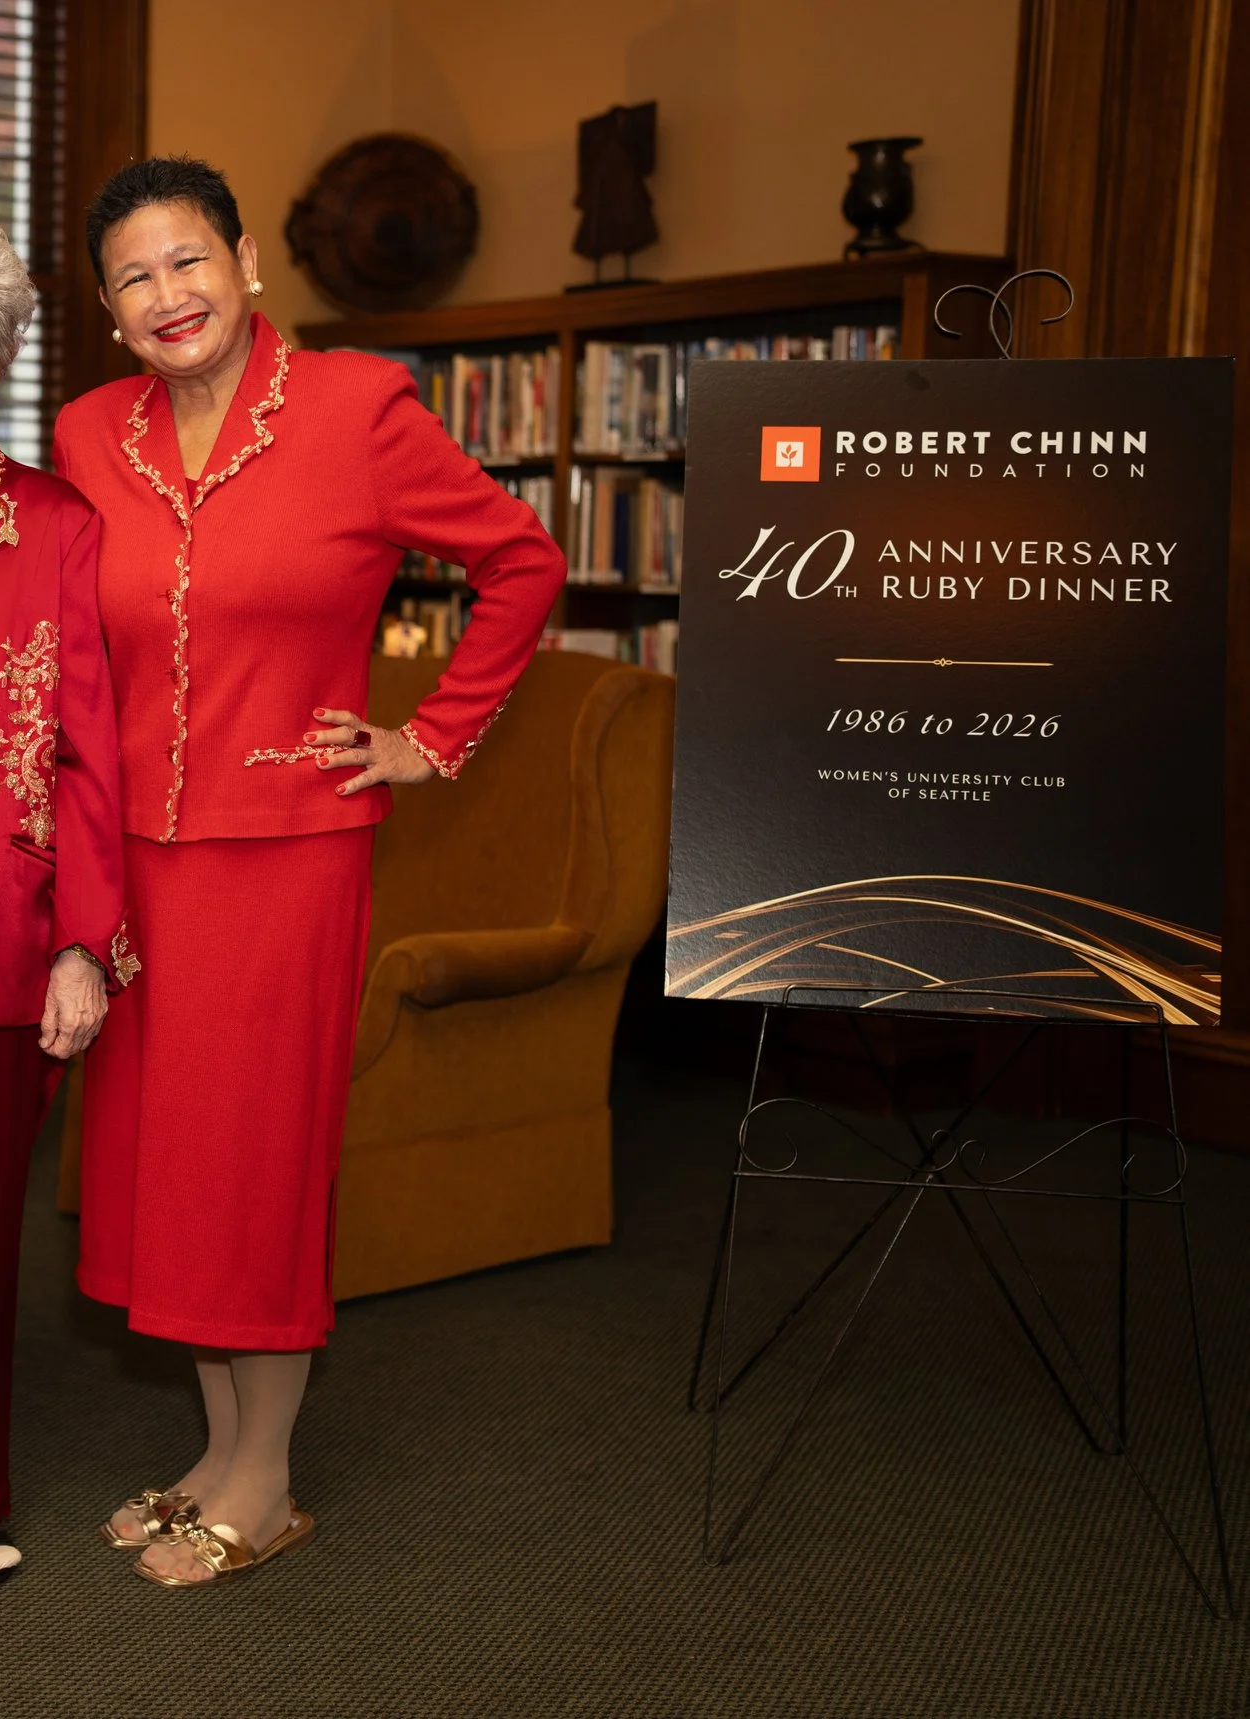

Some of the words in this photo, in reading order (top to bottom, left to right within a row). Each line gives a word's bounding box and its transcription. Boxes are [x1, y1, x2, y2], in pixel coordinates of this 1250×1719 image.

[837, 432, 990, 454] ROBERT
[1011, 431, 1146, 454] CHINN
[835, 462, 1144, 478] FOUNDATION
[878, 540, 1177, 565] ANNIVERSARY
[883, 576, 983, 599] RUBY
[1009, 578, 1172, 602] DINNER
[827, 709, 907, 733] 1986
[921, 715, 952, 734] to
[967, 713, 1060, 737] 2026
[817, 769, 898, 782] WOMEN'S
[907, 772, 1012, 786] UNIVERSITY
[1020, 775, 1065, 787] CLUB
[888, 787, 910, 799] OF
[918, 788, 991, 802] SEATTLE
